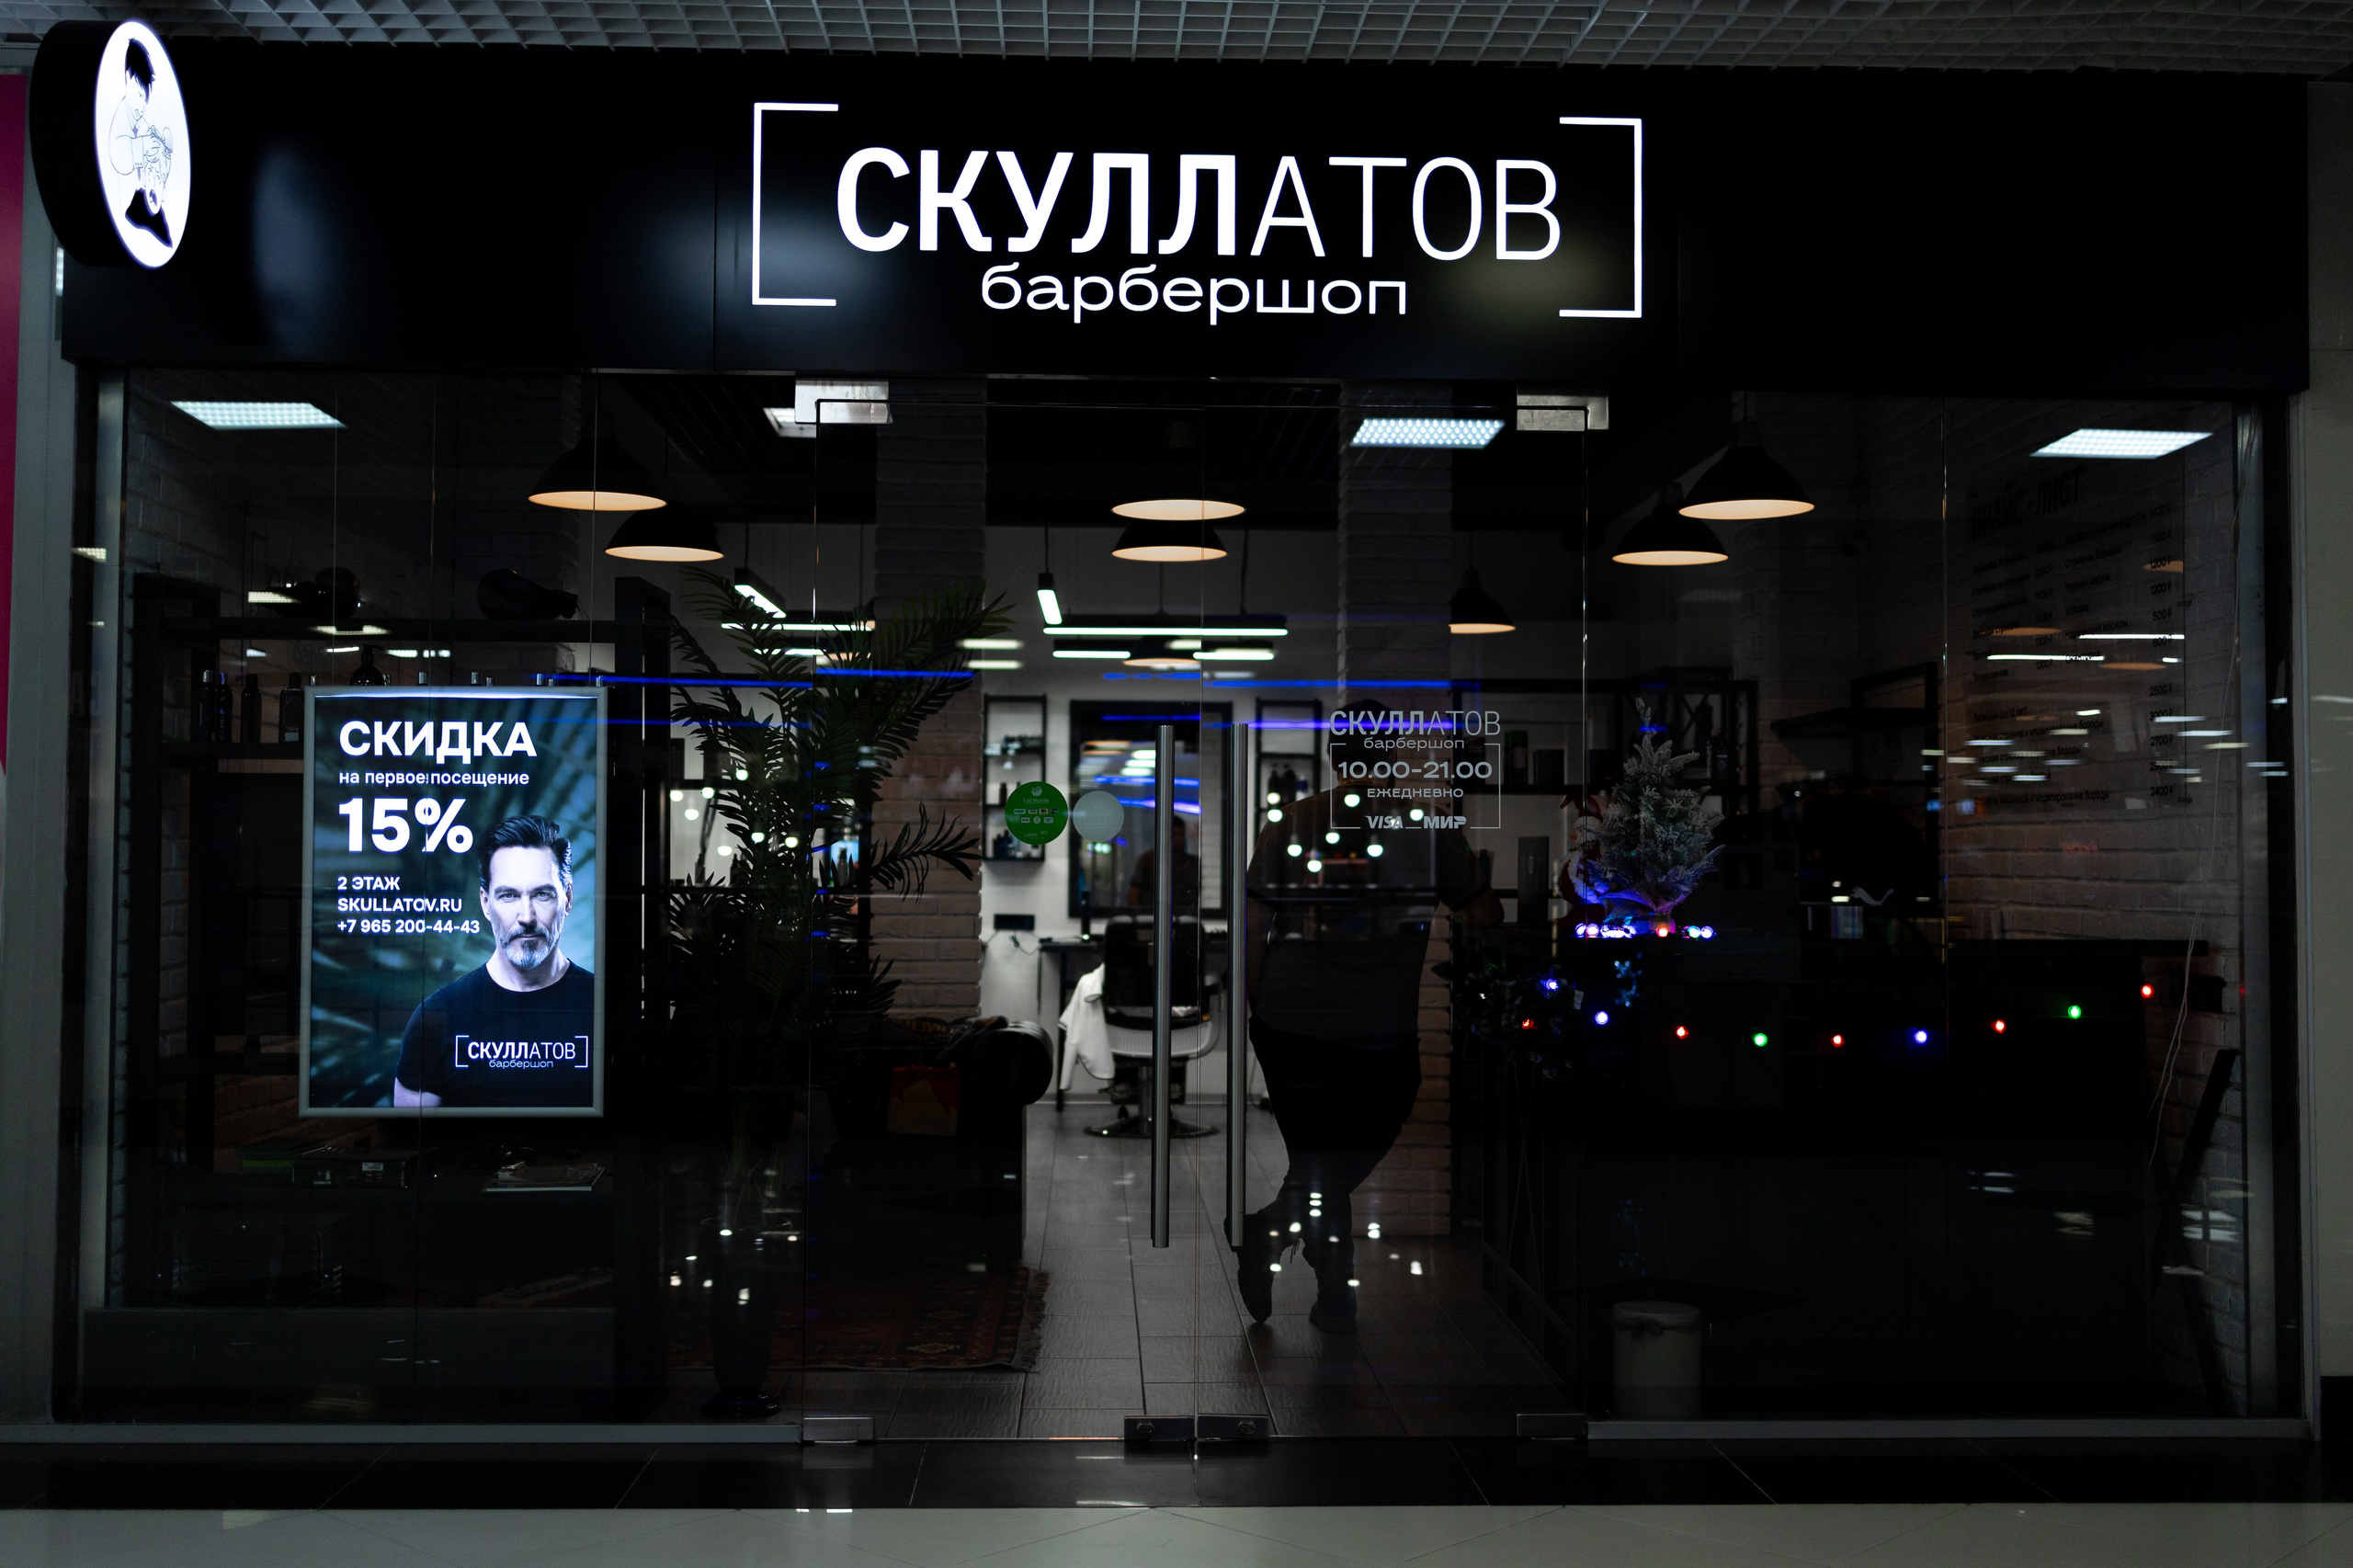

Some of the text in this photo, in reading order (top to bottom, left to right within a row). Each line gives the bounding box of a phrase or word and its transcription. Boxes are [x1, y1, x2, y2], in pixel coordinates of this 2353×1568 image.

[835, 146, 1562, 262] СКУЛЛАТОВ
[981, 262, 1407, 326] барбершоп
[1330, 710, 1501, 736] СКУЛЛАТОВ
[338, 720, 538, 765] СКИДКА
[1363, 737, 1465, 752] барбершоп
[1337, 761, 1493, 779] 10.00-21.00
[339, 771, 529, 788] на первое посещение
[1367, 788, 1464, 800] ЕЖЕДНЕВНО
[338, 796, 474, 855] 15%
[1365, 815, 1404, 829] VISA
[1424, 815, 1467, 829] МИР
[337, 876, 401, 891] 2 ЭТАЖ
[337, 898, 462, 912] SKULLATOV.RU
[337, 919, 480, 934] +7 965 200-44-43
[467, 1041, 576, 1060] СКУЛЛАТОВ
[489, 1059, 553, 1070] барбершоп
